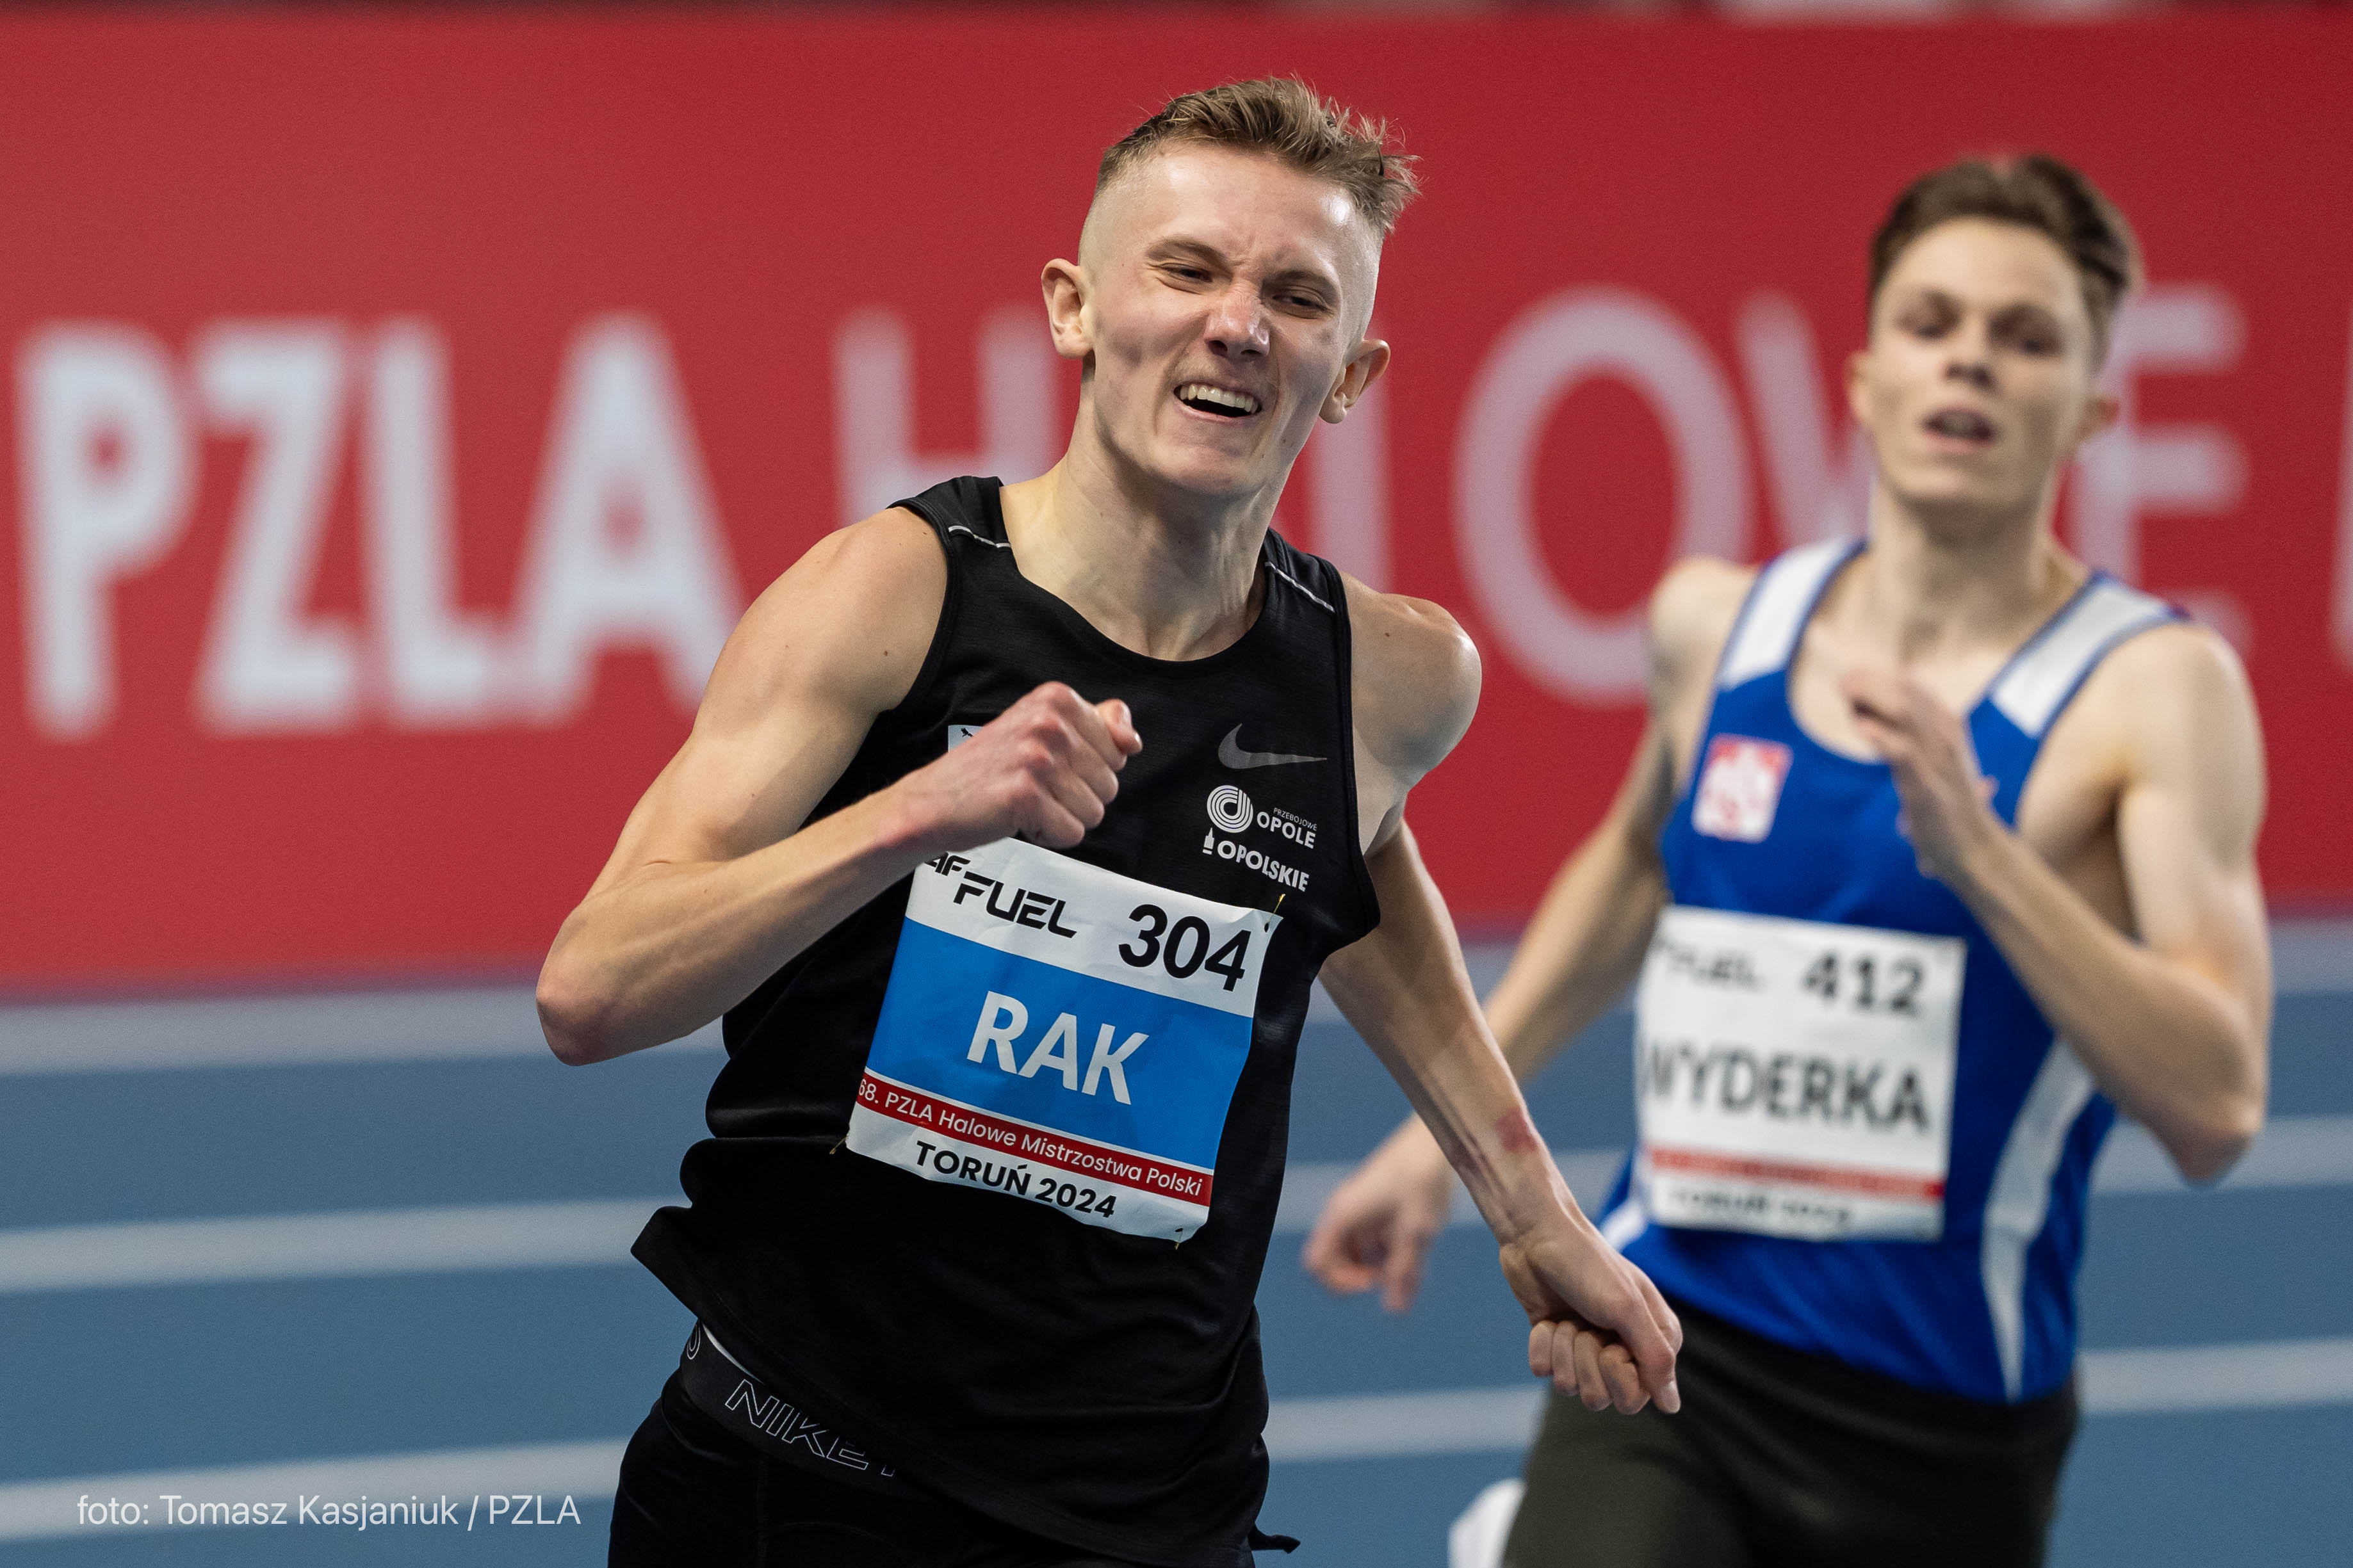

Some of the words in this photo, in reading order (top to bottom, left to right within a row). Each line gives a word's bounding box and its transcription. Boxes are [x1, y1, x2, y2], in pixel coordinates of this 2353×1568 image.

[19, 312, 746, 735] PZLA
[1257, 811, 1316, 849] OPOLE
[1273, 807, 1317, 831] PRZEBOJOWE
[953, 871, 1077, 939] FUEL
[1217, 840, 1310, 892] OPOLSKIE
[1118, 903, 1251, 992] 304
[1801, 949, 1926, 1017] 412
[966, 990, 1150, 1106] RAK
[859, 1079, 879, 1104] 68.
[885, 1092, 932, 1122] PZLA
[939, 1110, 1017, 1146] Halowe
[1021, 1134, 1142, 1181] Mistrzostwa
[1146, 1167, 1203, 1196] Polski
[916, 1140, 1032, 1196] TORUŃ
[1035, 1178, 1117, 1218] 2024
[725, 1379, 869, 1470] NIKE
